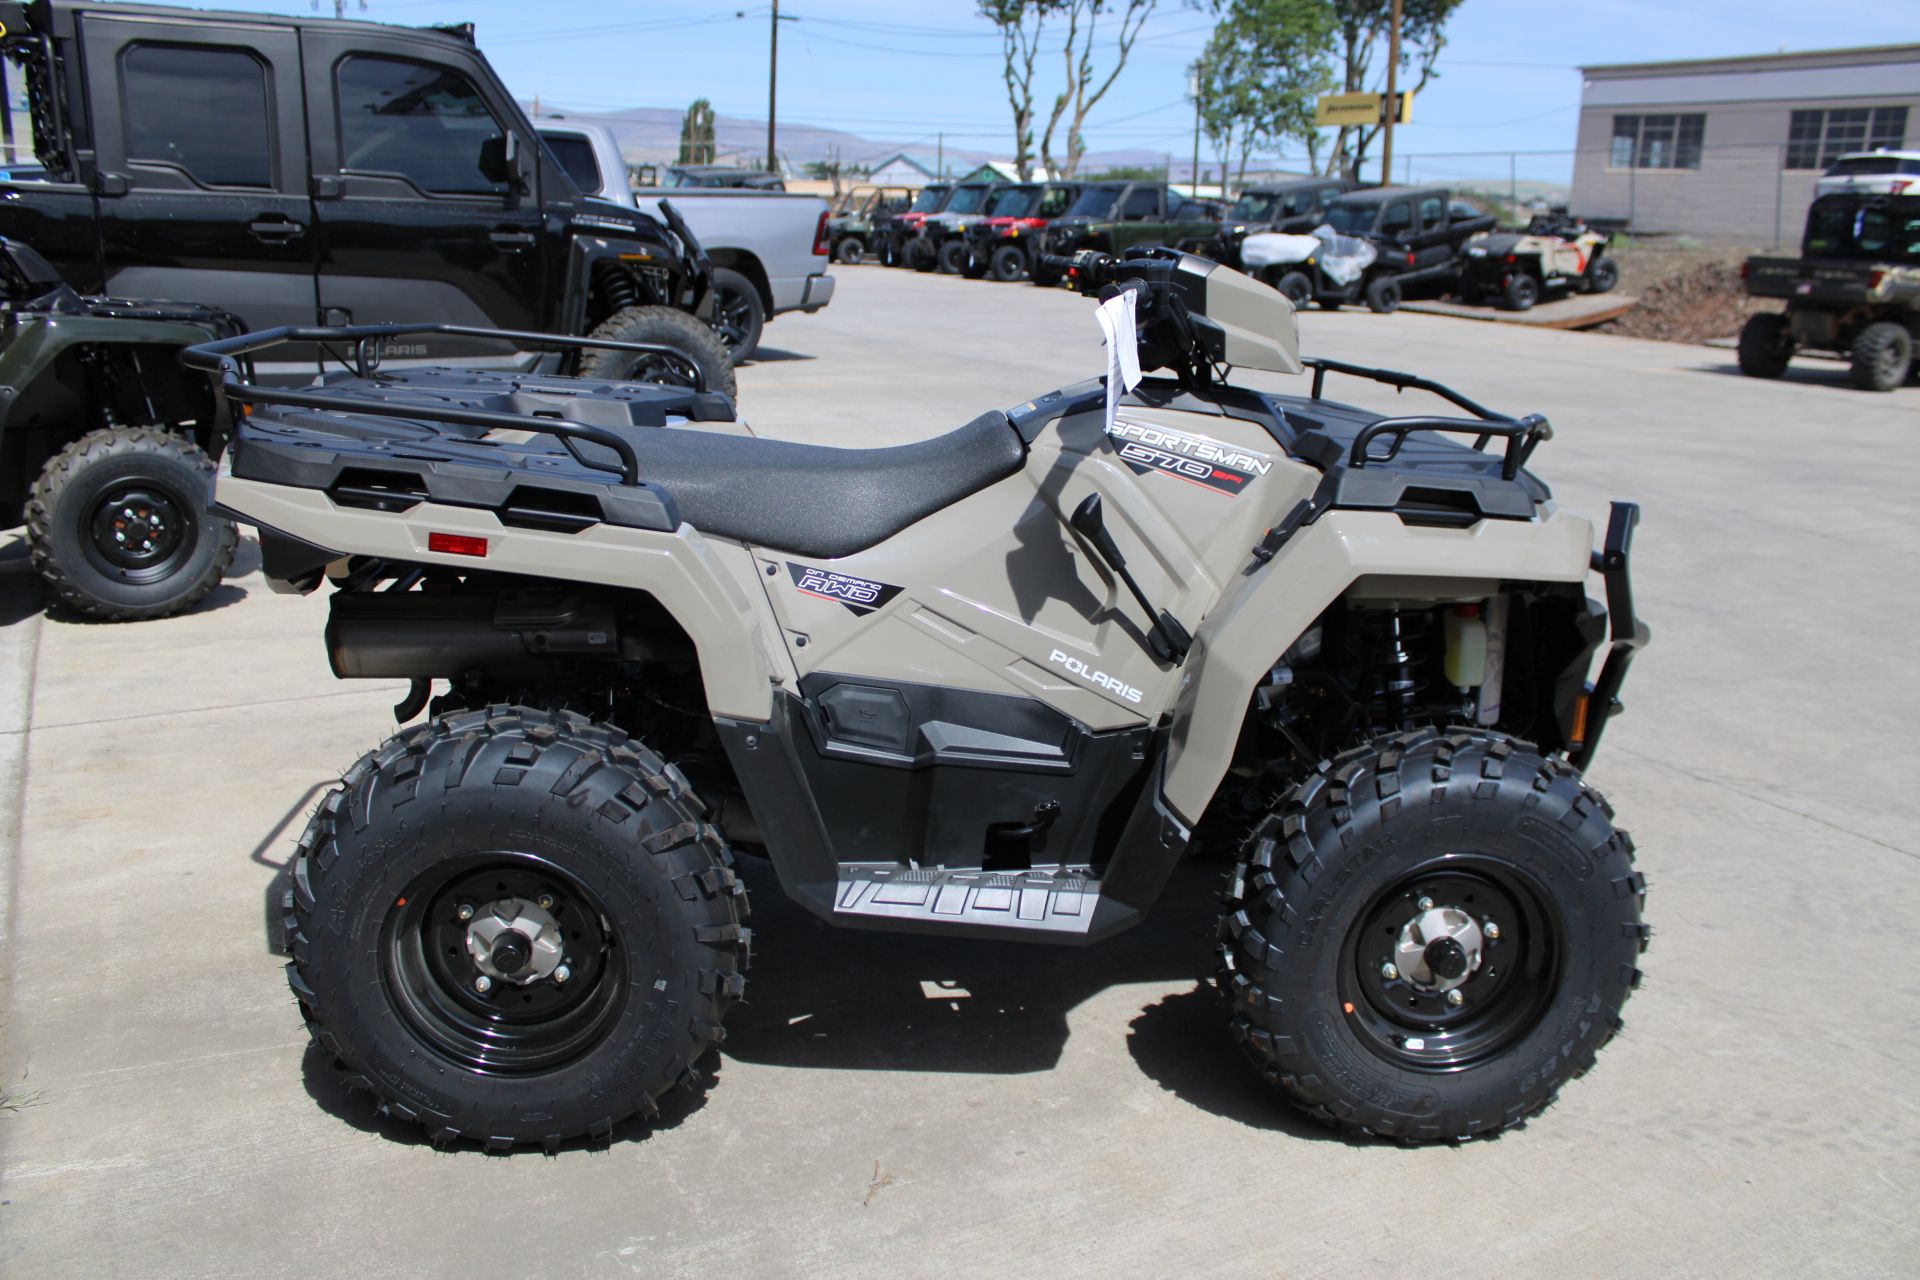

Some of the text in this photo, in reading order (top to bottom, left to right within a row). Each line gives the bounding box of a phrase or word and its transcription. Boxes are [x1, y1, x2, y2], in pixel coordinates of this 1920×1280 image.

[1103, 420, 1273, 477] SPORTSMAN
[1119, 442, 1213, 479] 570
[797, 574, 878, 603] AWD
[828, 574, 882, 591] DEMAND
[1048, 648, 1144, 704] POLARIS
[1298, 832, 1397, 952] CARLSTAR
